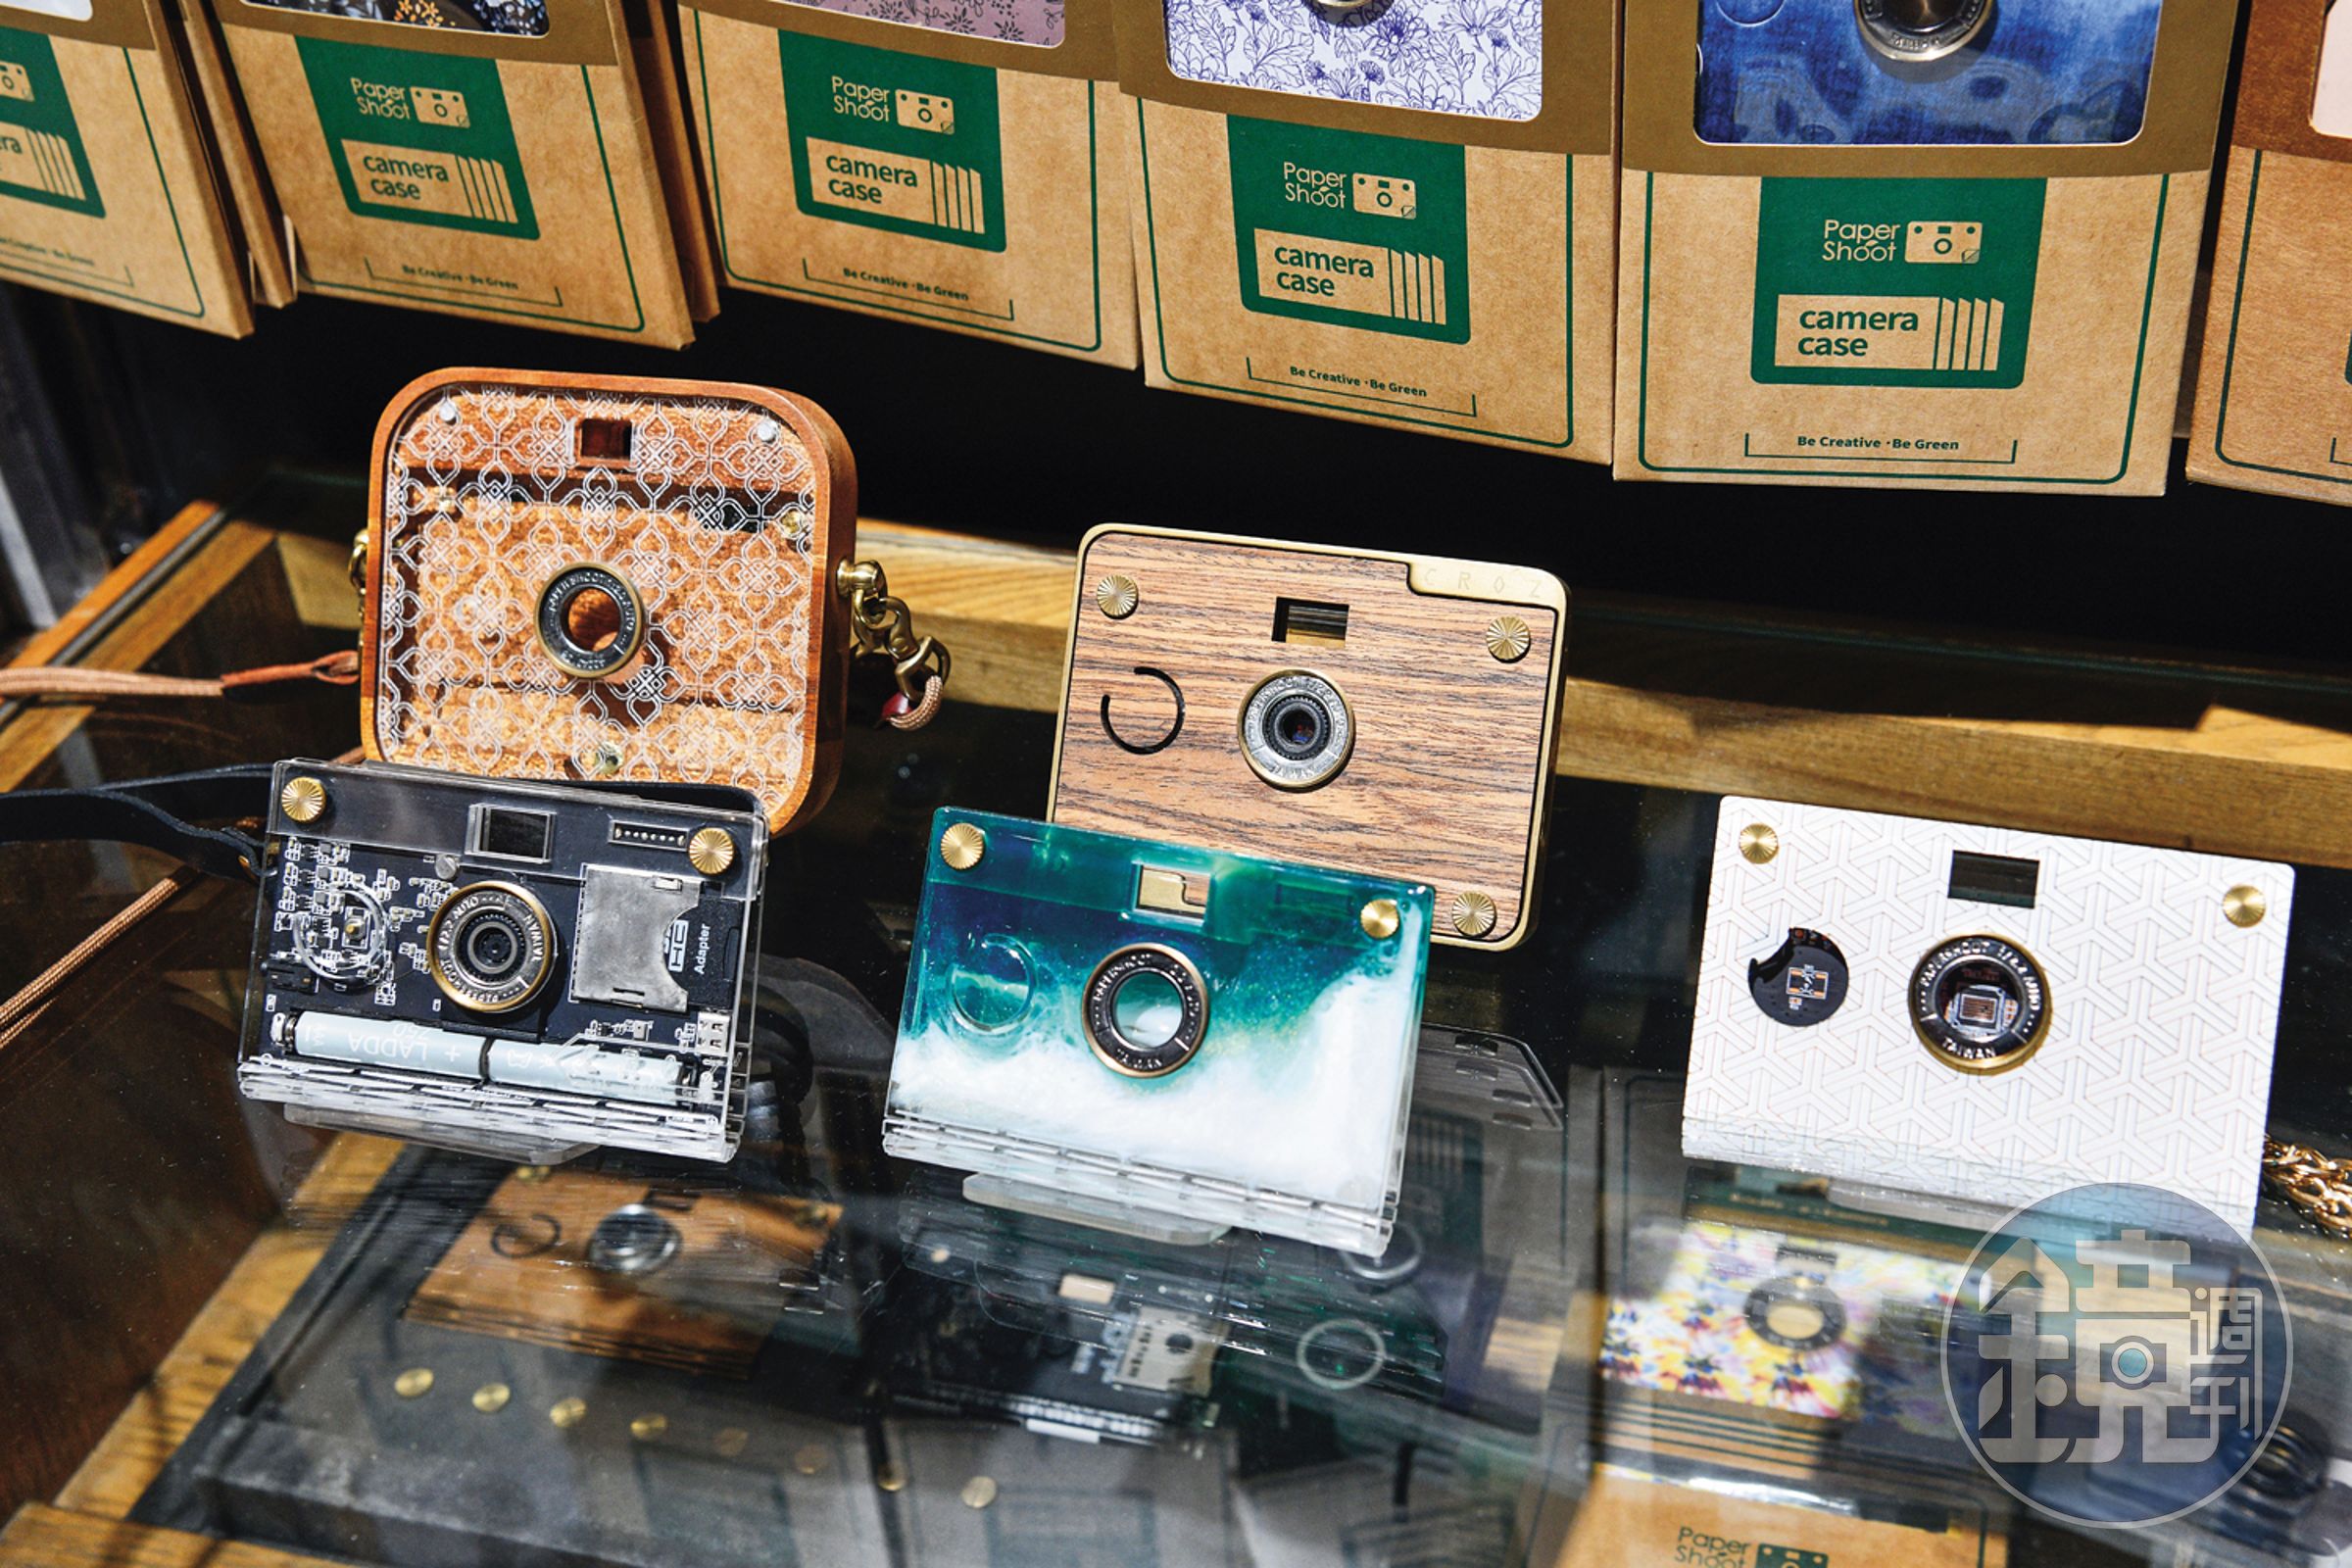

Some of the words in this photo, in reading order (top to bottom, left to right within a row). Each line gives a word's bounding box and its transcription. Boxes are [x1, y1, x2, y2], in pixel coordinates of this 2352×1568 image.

[350, 76, 405, 102] Paper
[831, 75, 890, 103] Paper
[357, 96, 411, 120] Shoot
[833, 95, 890, 122] Shoot
[363, 156, 449, 182] camera
[826, 155, 917, 188] camera
[1283, 161, 1348, 189] Paper
[370, 178, 420, 200] case
[828, 178, 882, 204] case
[1285, 182, 1347, 209] Shoot
[1824, 219, 1901, 244] Paper
[1274, 246, 1374, 278] camera
[1822, 240, 1897, 262] Shoot
[843, 268, 858, 278] Be
[860, 270, 908, 289] Creative
[934, 286, 968, 301] Green
[1277, 271, 1335, 297] case
[1799, 310, 1919, 331] camera
[1797, 337, 1869, 357] case
[1290, 366, 1305, 377] Be
[1308, 369, 1360, 386] Creative
[1389, 382, 1427, 397] Green
[1797, 436, 1816, 447] Be
[1819, 436, 1882, 449] Creative
[1914, 439, 1959, 450] Green
[1425, 568, 1543, 599] CROZ
[693, 922, 710, 975] Adapter
[348, 1032, 429, 1061] LADDA
[1941, 1036, 1996, 1059] TAIWAN
[1678, 1526, 1751, 1555] Paper
